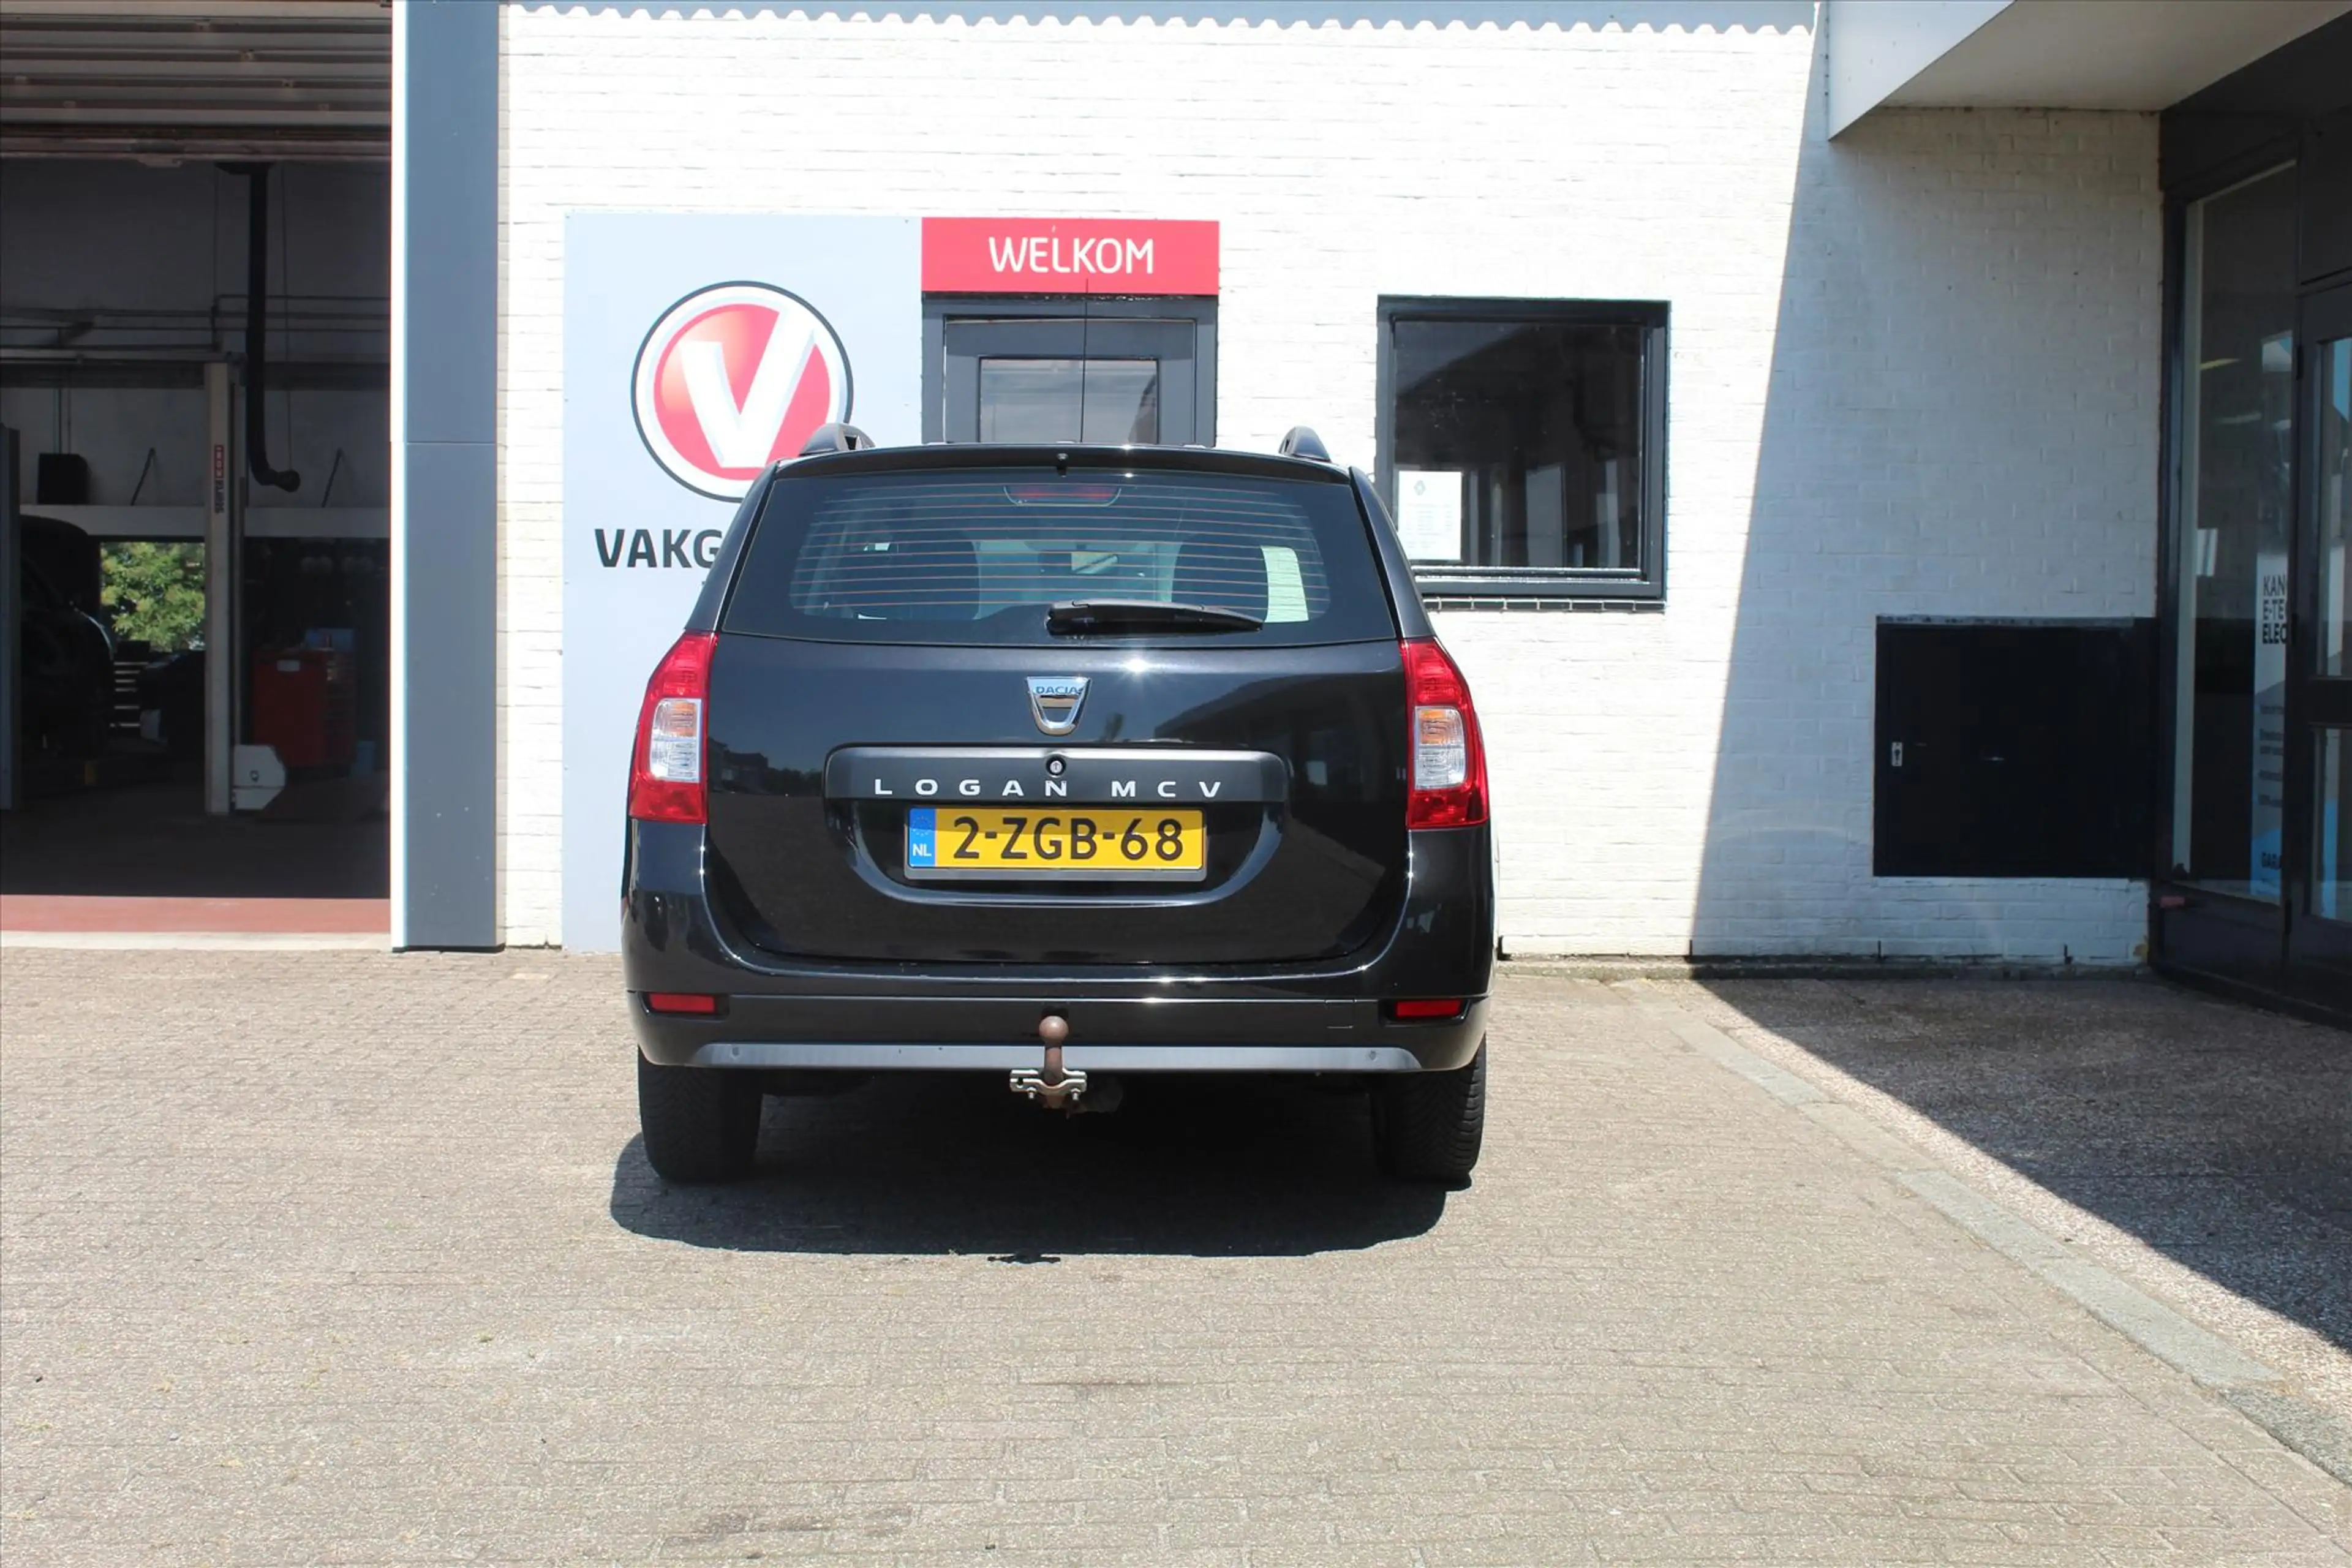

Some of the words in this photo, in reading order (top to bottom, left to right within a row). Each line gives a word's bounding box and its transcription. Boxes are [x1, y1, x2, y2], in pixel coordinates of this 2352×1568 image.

[989, 236, 1154, 274] WELKOM
[595, 529, 723, 568] VAKG
[875, 779, 1068, 797] LOGAN
[1111, 780, 1221, 798] MCV
[912, 843, 932, 856] NL
[953, 816, 1184, 861] 2-ZGB-68
